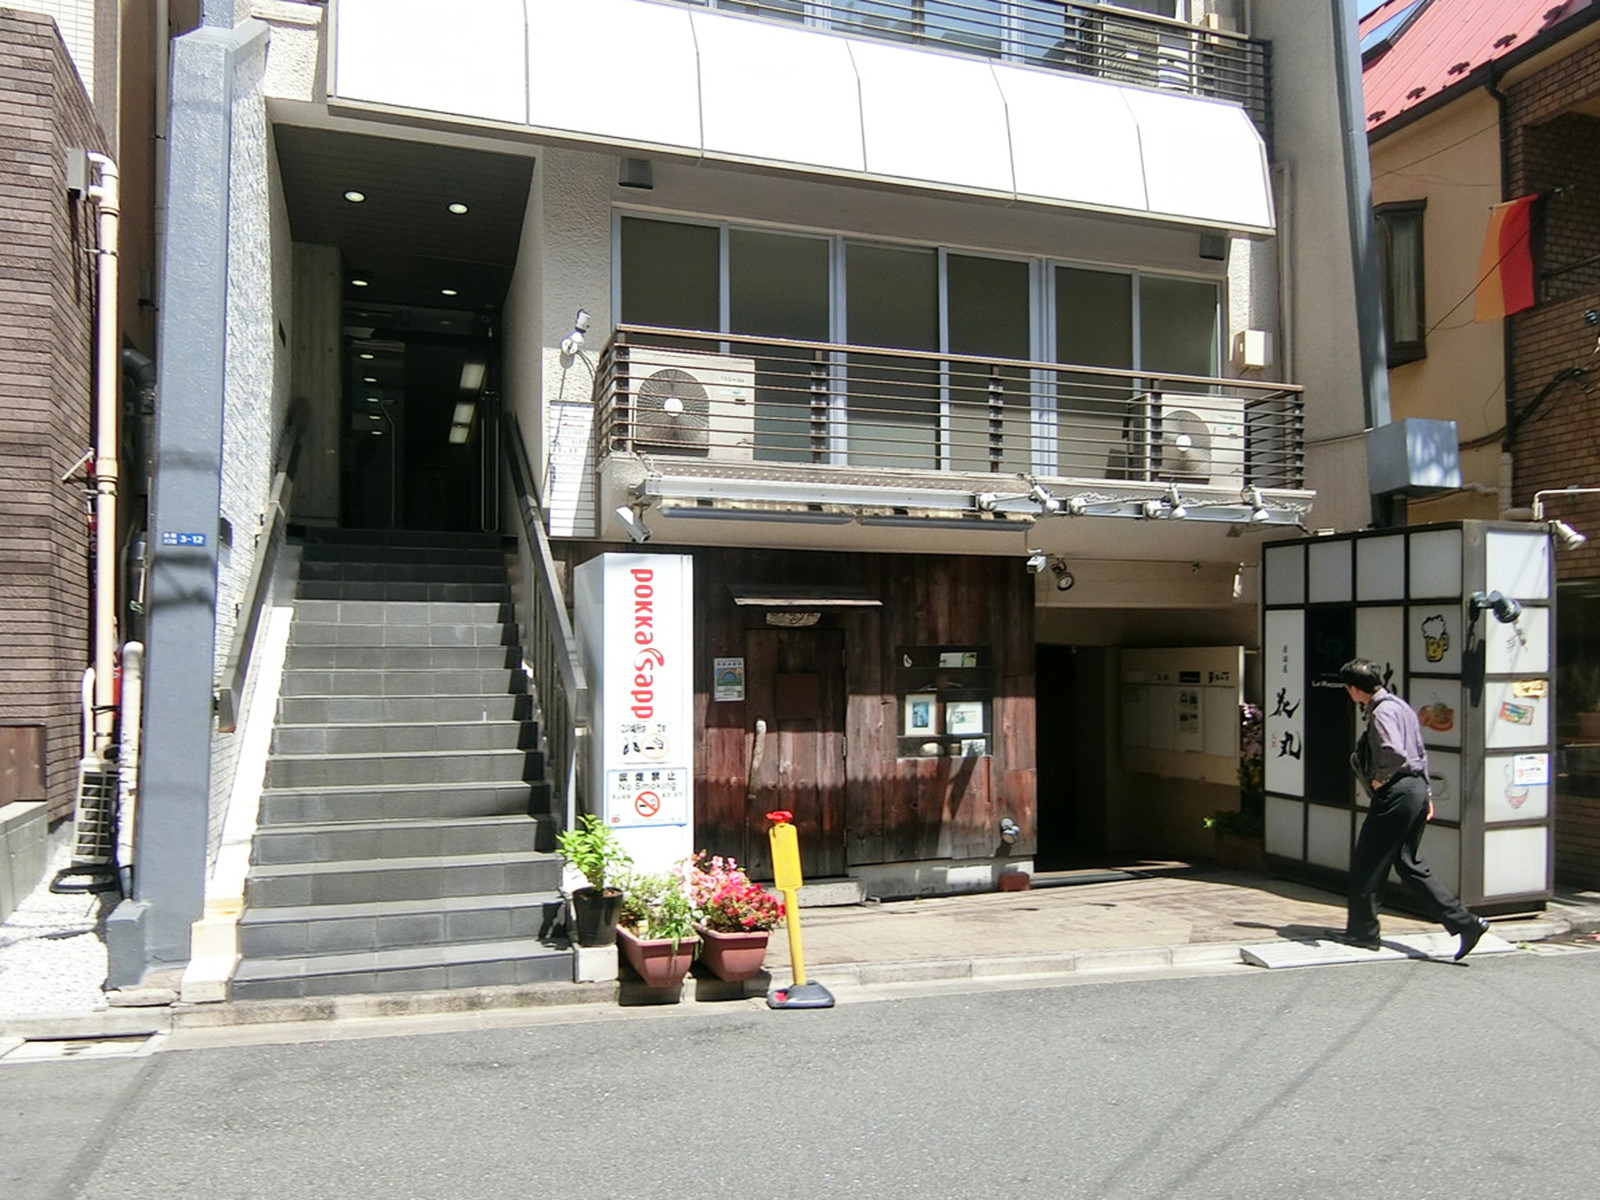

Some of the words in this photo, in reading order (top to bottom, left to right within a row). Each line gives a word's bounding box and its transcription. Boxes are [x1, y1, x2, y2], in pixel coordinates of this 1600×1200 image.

[179, 534, 204, 544] 3-12
[618, 783, 632, 792] No
[634, 782, 677, 792] Smoking
